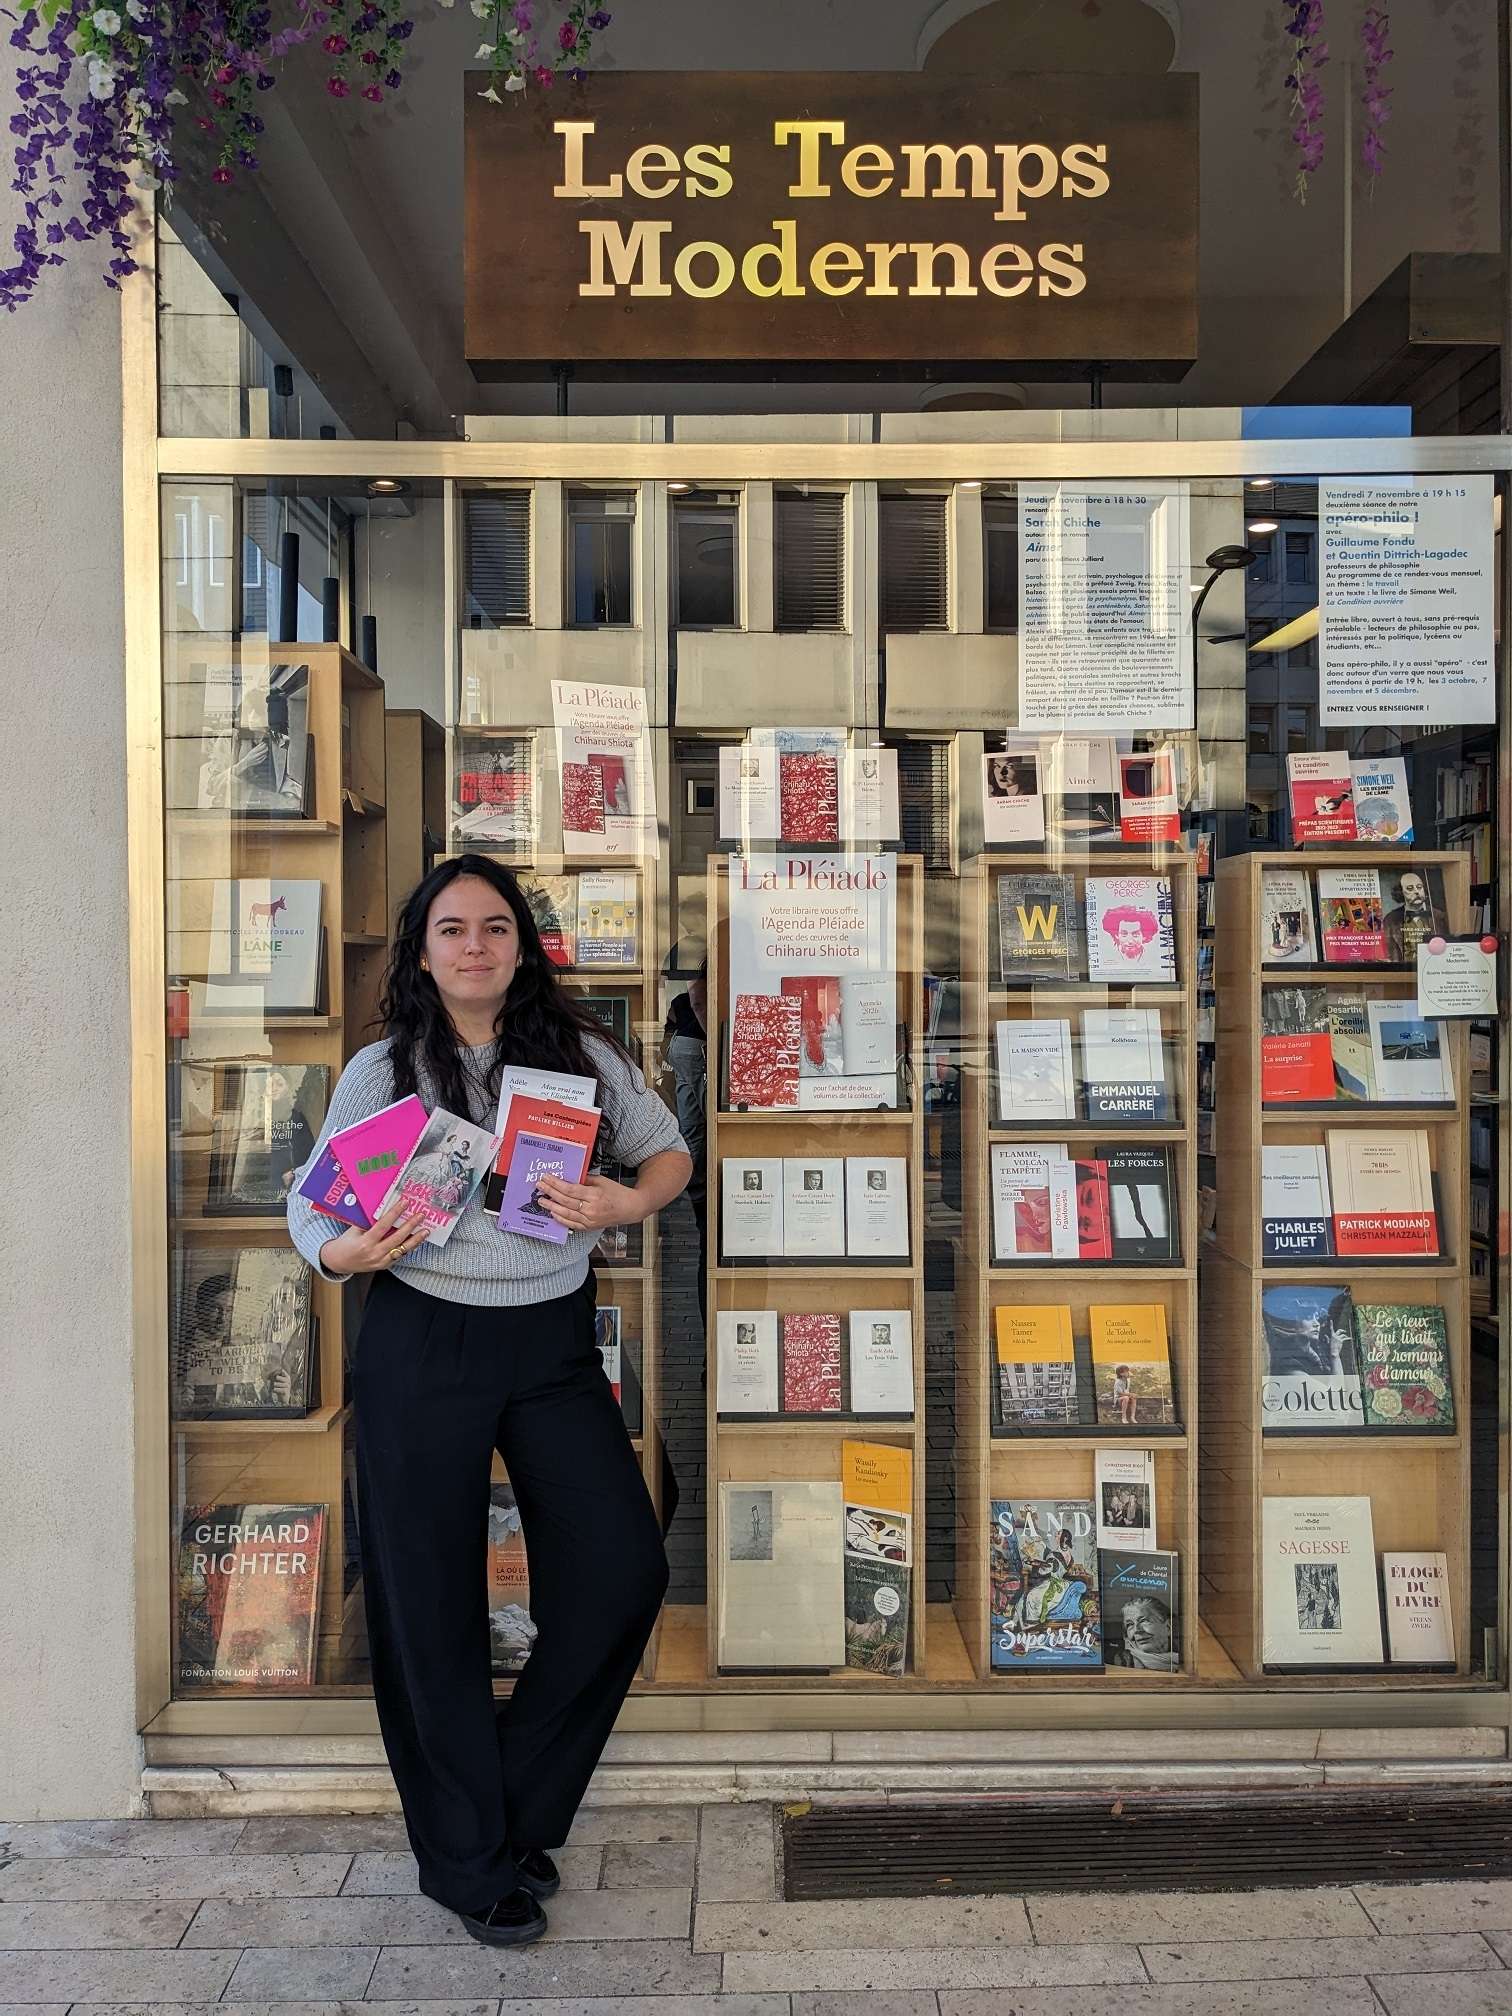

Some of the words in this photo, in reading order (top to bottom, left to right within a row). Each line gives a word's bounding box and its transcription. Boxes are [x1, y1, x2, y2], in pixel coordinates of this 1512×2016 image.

[552, 121, 733, 199] Les
[774, 120, 1110, 221] Temps
[578, 219, 1087, 298] Modernes
[1113, 495, 1123, 503] 18
[1127, 495, 1133, 503] h
[1135, 495, 1146, 503] 30
[1375, 490, 1420, 498] novembre
[1025, 517, 1060, 527] Sarah
[1063, 517, 1101, 527] Chiche
[1326, 511, 1409, 526] apéro-philo
[1414, 511, 1419, 522] !
[1326, 538, 1379, 547] Guillaume
[1383, 537, 1415, 546] Fondu
[1326, 552, 1336, 560] et
[1339, 551, 1380, 560] Quentin
[1384, 548, 1468, 561] Dittrich-Lagadec
[1379, 562, 1420, 570] philosophie
[1338, 572, 1381, 580] programme
[1451, 569, 1483, 577] mensuel,
[1443, 615, 1480, 623] pré-requis
[556, 686, 580, 706] La
[584, 687, 642, 711] Pléiade
[574, 736, 606, 747] Chiharu
[608, 738, 633, 748] Shiota
[1356, 775, 1381, 786] SIMONE
[1381, 774, 1395, 785] WEIL
[740, 860, 777, 890] La
[786, 859, 887, 890] Pléiade
[1105, 880, 1150, 889] GEORGES
[1114, 889, 1143, 897] PEREC
[770, 907, 791, 915] Votre
[792, 906, 819, 915] libraire
[820, 907, 838, 915] vous
[839, 906, 859, 915] offre
[761, 918, 815, 933] l'Agenda
[819, 918, 865, 929] Pléiade
[1016, 905, 1058, 940] W
[795, 933, 808, 941] des
[839, 933, 849, 941] de
[244, 937, 282, 951] L'ÂNE
[766, 944, 815, 957] Chiharu
[819, 944, 860, 957] Shiota
[1012, 948, 1045, 956] GEORGES
[777, 997, 801, 1071] Pléiade
[1264, 1055, 1274, 1063] La
[1274, 1054, 1303, 1063] surprise
[541, 1083, 556, 1091] Mon
[1092, 1086, 1160, 1096] EMMANUEL
[550, 1092, 578, 1102] Elisabeth
[1099, 1098, 1154, 1111] CARRÈRE
[271, 1120, 304, 1130] Berthe
[271, 1130, 293, 1140] Weill
[530, 1158, 564, 1171] L'ENVERS
[1000, 1166, 1042, 1174] TEMPÊTE
[526, 1172, 538, 1182] DES
[1265, 1222, 1325, 1234] CHARLES
[1340, 1220, 1380, 1230] PATRICK
[1384, 1219, 1430, 1229] MODIANO
[1341, 1231, 1386, 1240] CHRISTIAN
[1388, 1230, 1431, 1239] MAZZALAI
[1275, 1236, 1317, 1250] JULIET
[1373, 1311, 1393, 1327] Le
[1396, 1313, 1430, 1327] vieux
[1376, 1331, 1397, 1344] qui
[1400, 1327, 1436, 1344] lisait
[786, 1342, 814, 1350] Chiharu
[1367, 1346, 1391, 1362] des
[1392, 1348, 1443, 1362] romans
[1379, 1365, 1433, 1380] d'amour
[1262, 1381, 1363, 1411] Colette
[854, 1457, 877, 1469] Wassily
[855, 1466, 888, 1480] Kandinsky
[998, 1511, 1092, 1537] SAND
[195, 1524, 309, 1544] GERHARD
[1279, 1540, 1351, 1555] SAGESSE
[192, 1552, 307, 1575] RICHTER
[507, 1566, 517, 1574] OÙ
[1391, 1565, 1443, 1578] ÉLOGE
[1407, 1581, 1428, 1593] DU
[1395, 1595, 1443, 1608] LIVRE
[1000, 1623, 1097, 1652] Superstar
[181, 1669, 231, 1677] FONDATION
[234, 1668, 259, 1677] LOUIS
[262, 1668, 298, 1677] VUITTON
